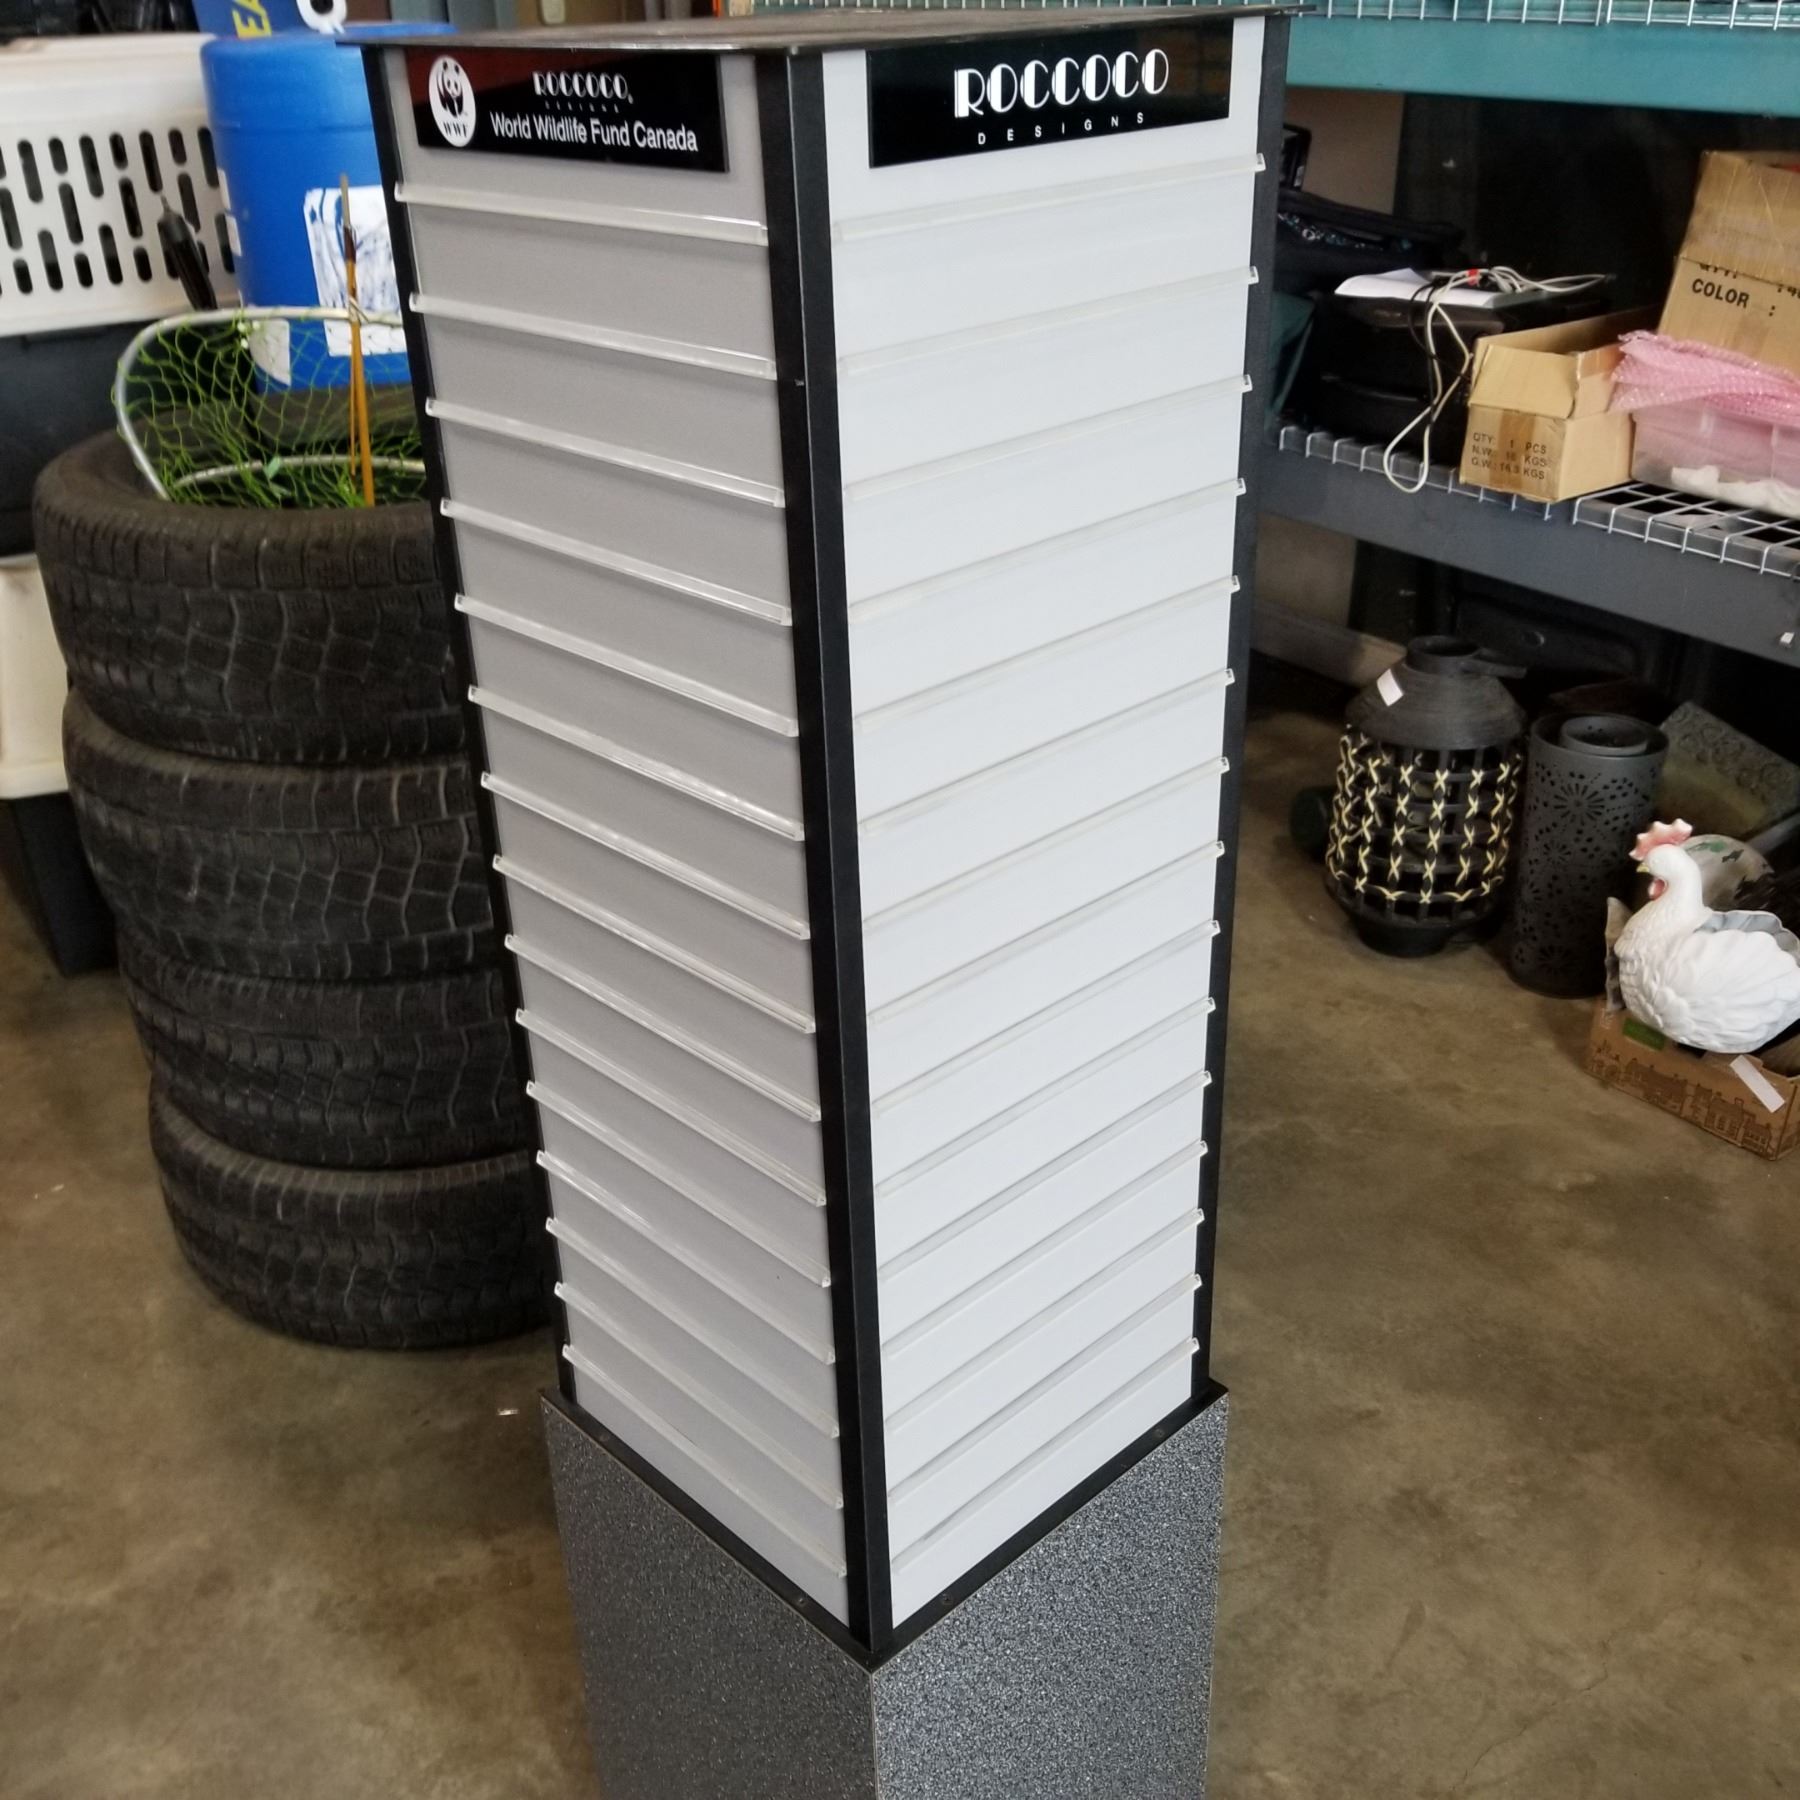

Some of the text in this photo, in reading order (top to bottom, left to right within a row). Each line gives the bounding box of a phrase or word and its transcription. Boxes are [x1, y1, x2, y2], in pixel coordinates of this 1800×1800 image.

[532, 71, 629, 100] ROCCOCO
[953, 48, 1170, 118] ROCCOCO
[490, 111, 699, 152] World Wildlife Fund Canada
[977, 112, 1144, 145] DESIGNS
[1692, 278, 1750, 309] COLOR
[1525, 441, 1547, 455] PCS
[1523, 467, 1545, 480] KGS
